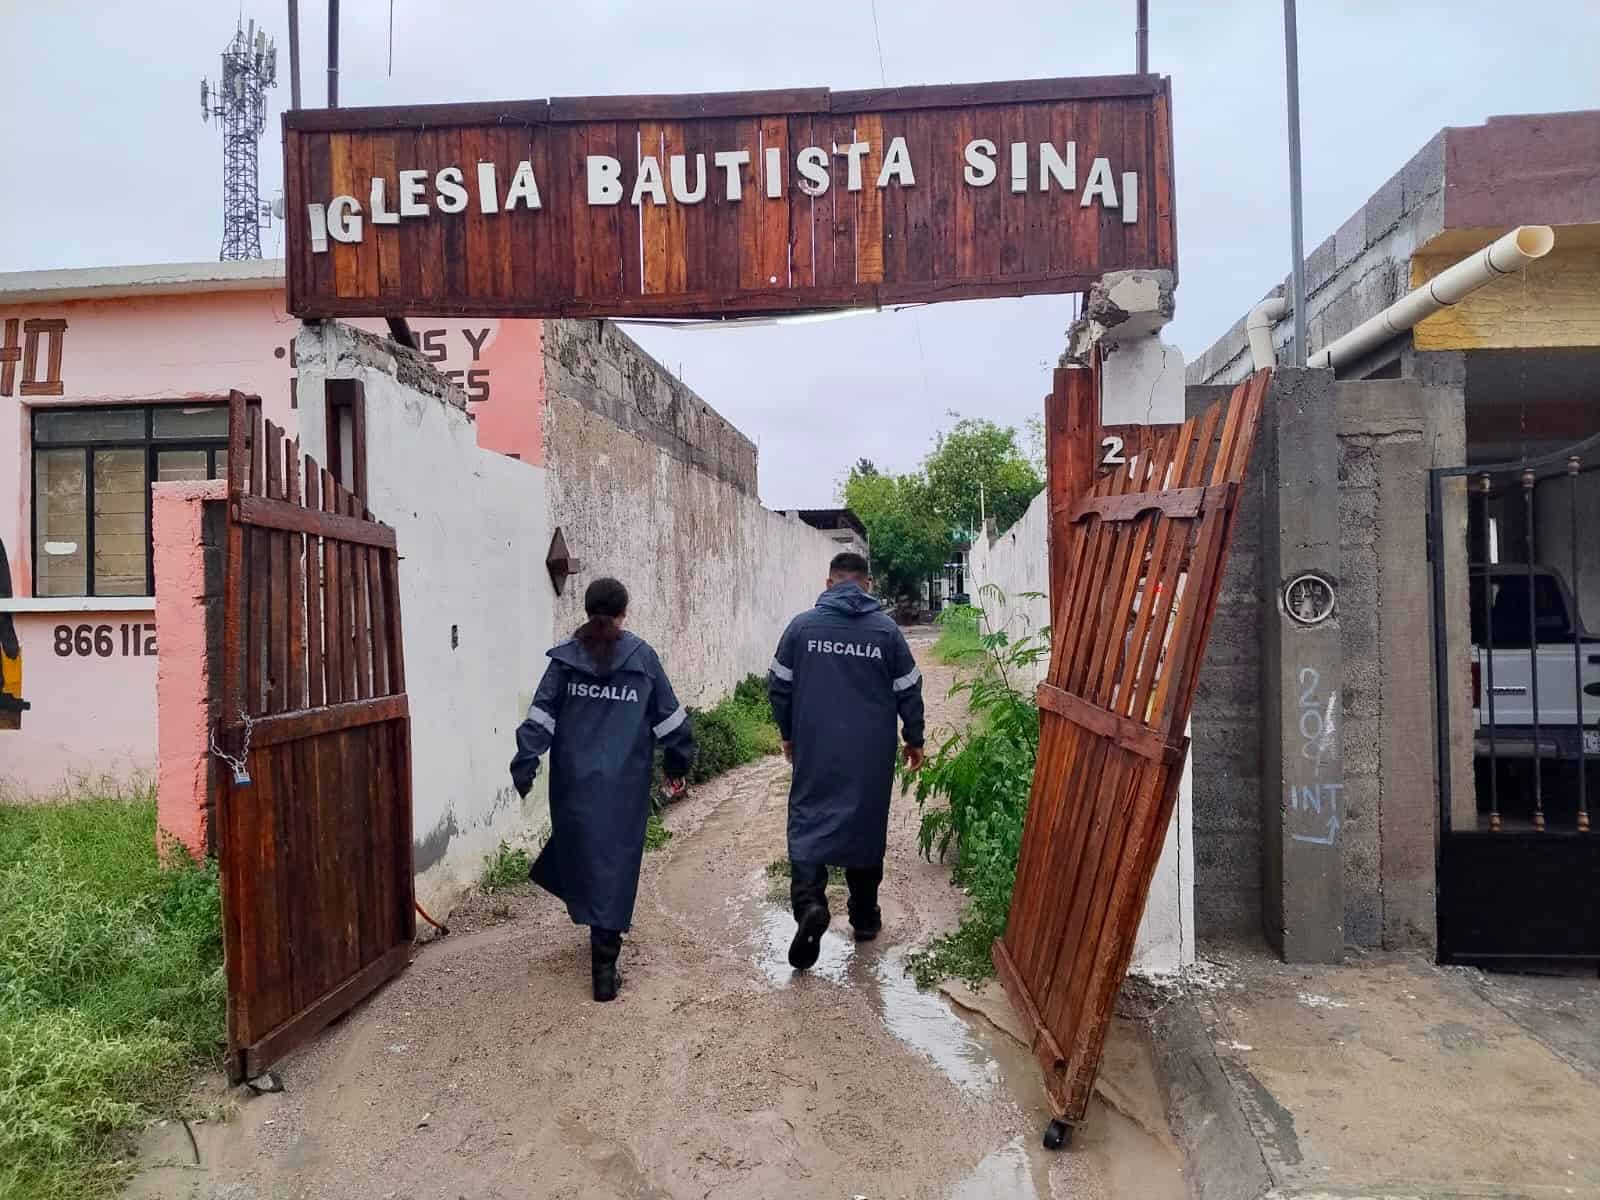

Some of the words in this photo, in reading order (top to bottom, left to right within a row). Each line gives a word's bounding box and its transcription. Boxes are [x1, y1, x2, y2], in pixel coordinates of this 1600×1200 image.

[308, 160, 541, 253] IGLESIA
[586, 137, 915, 207] BAUTISTA
[964, 138, 1138, 224] SINAI
[54, 624, 113, 657] 866
[807, 640, 882, 660] FISCALÍA
